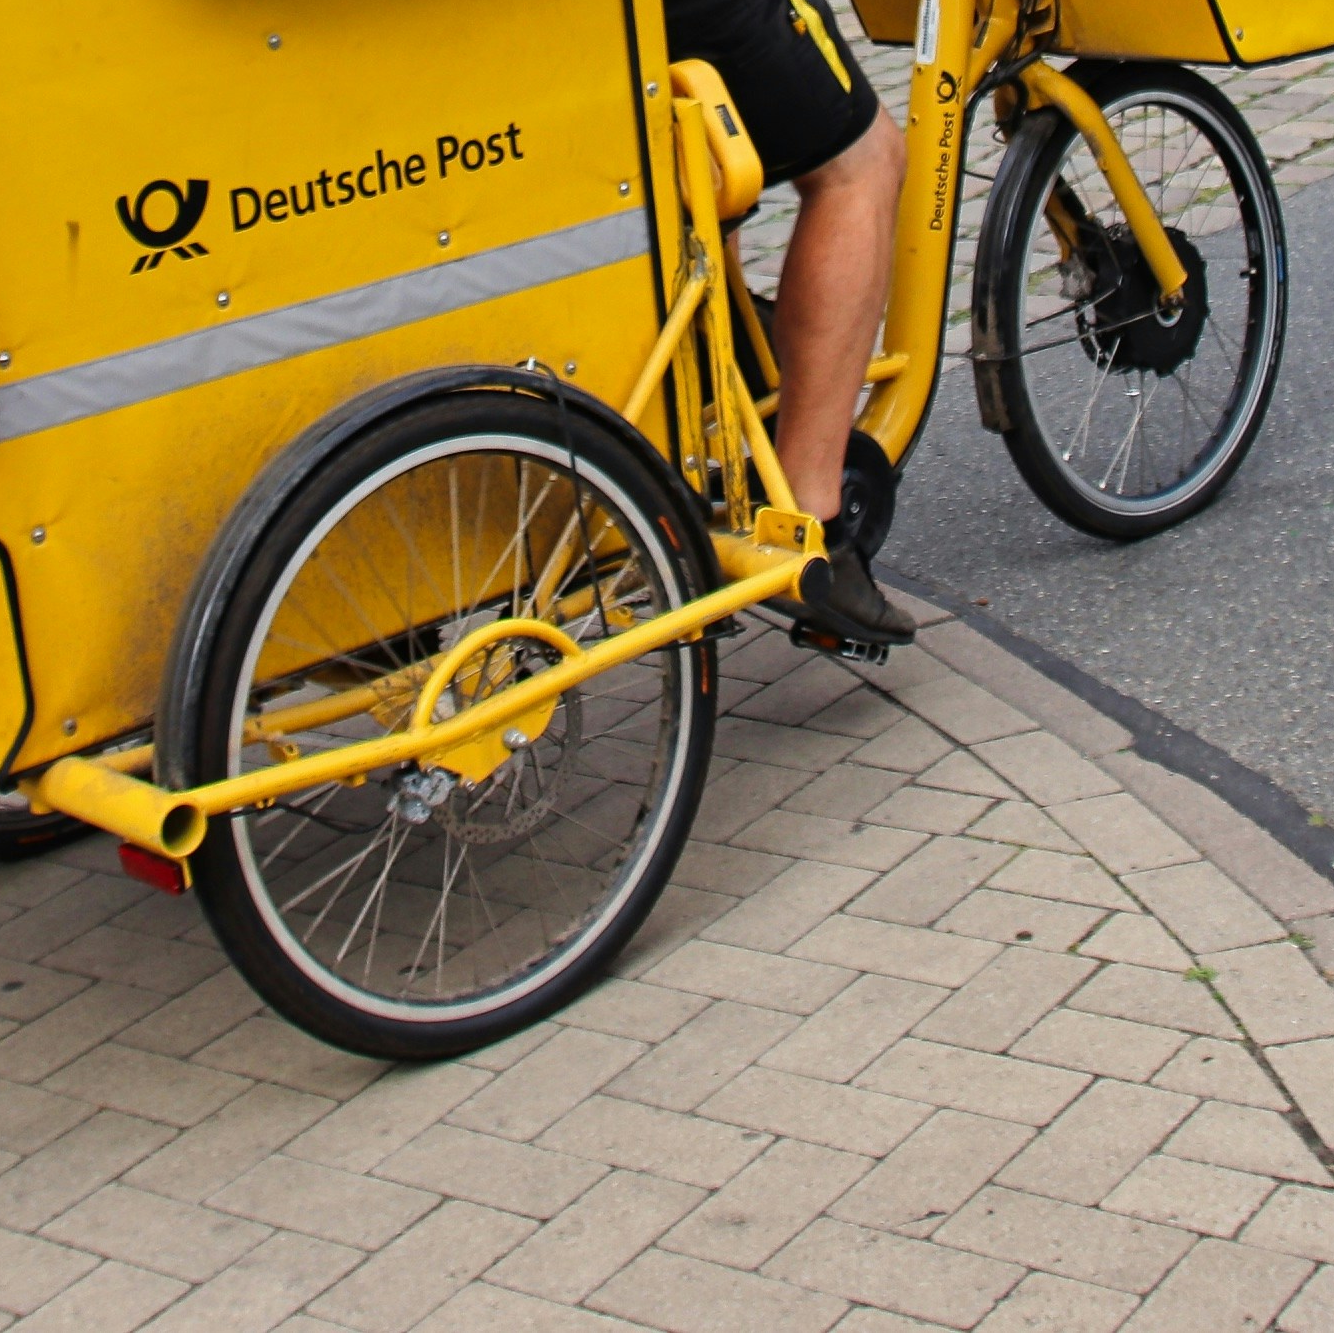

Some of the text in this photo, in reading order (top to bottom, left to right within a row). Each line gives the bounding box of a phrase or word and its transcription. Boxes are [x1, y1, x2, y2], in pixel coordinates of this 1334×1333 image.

[229, 122, 524, 233] Deutsche Post
[930, 111, 956, 232] Deutsche Post
